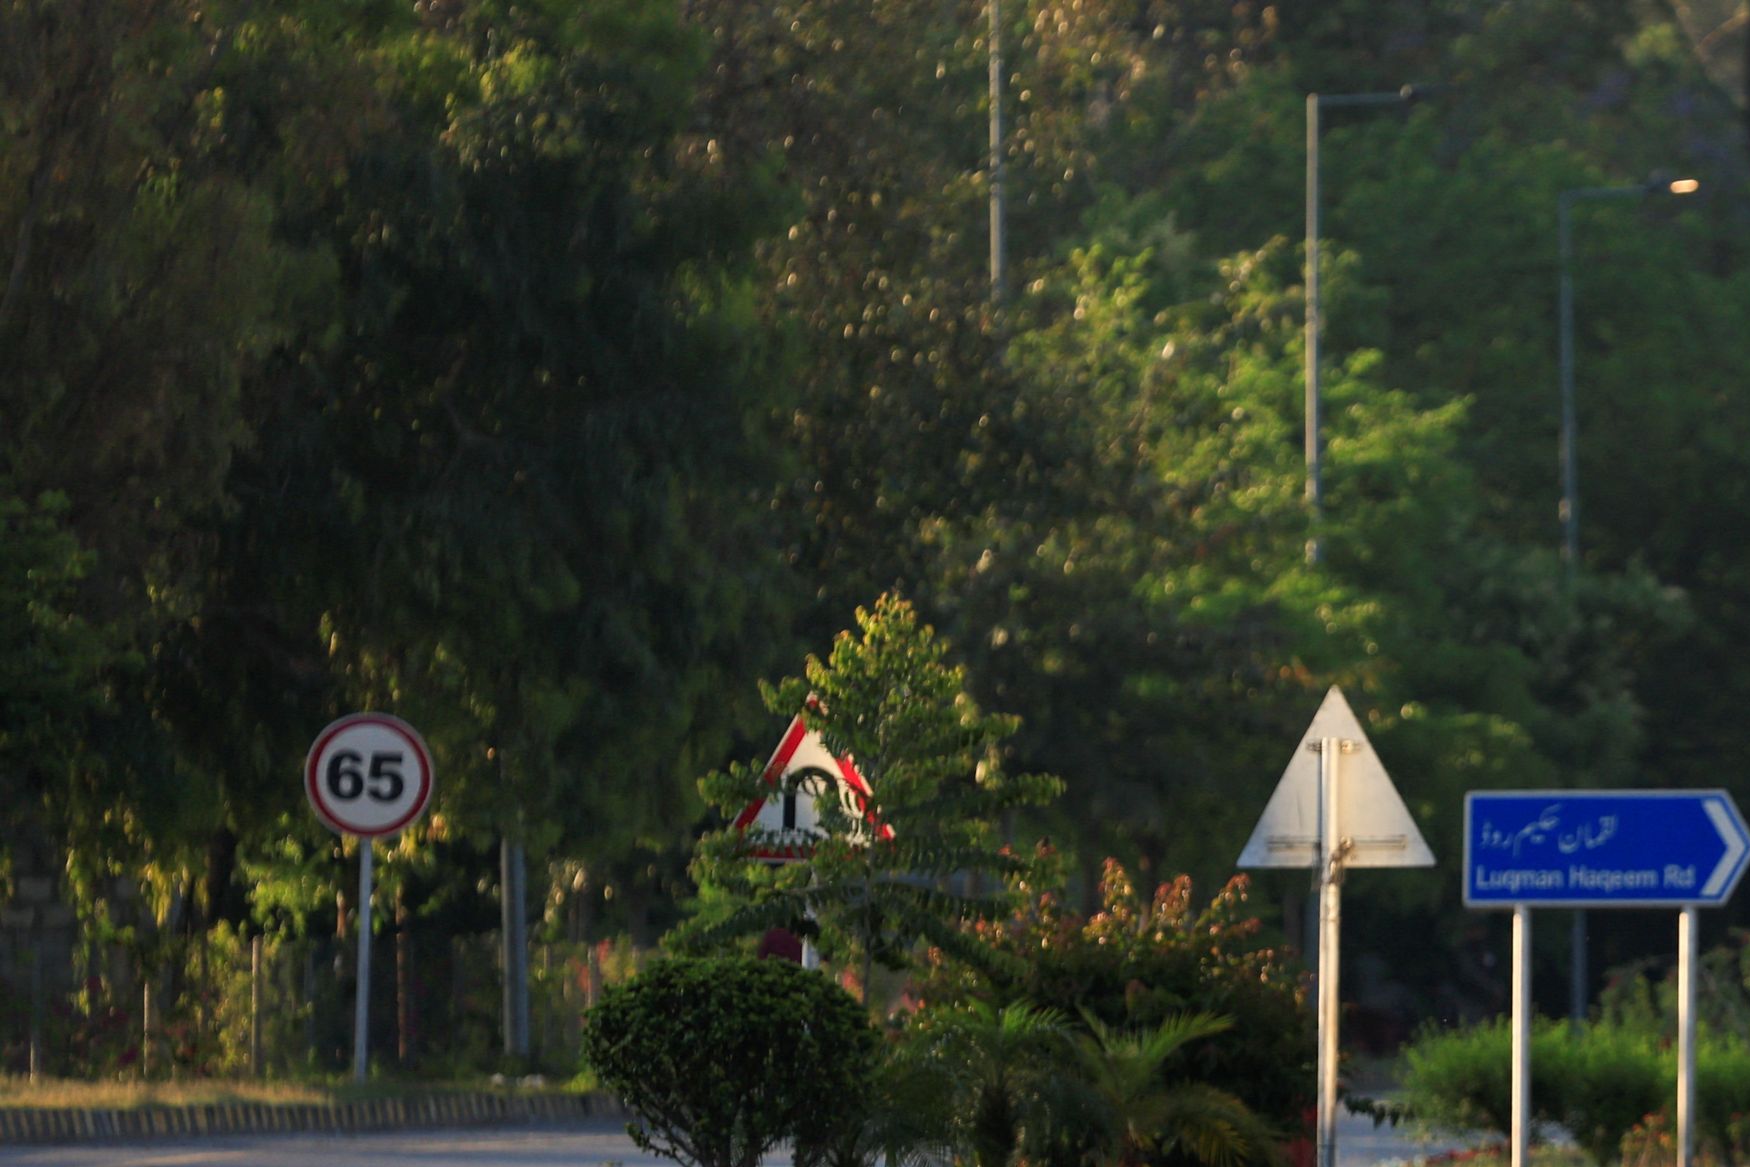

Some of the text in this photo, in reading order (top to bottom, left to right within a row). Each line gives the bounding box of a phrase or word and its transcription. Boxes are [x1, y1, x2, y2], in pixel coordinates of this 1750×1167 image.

[326, 748, 404, 802] 65
[1475, 864, 1696, 892] Luqman Haqeem Rd
